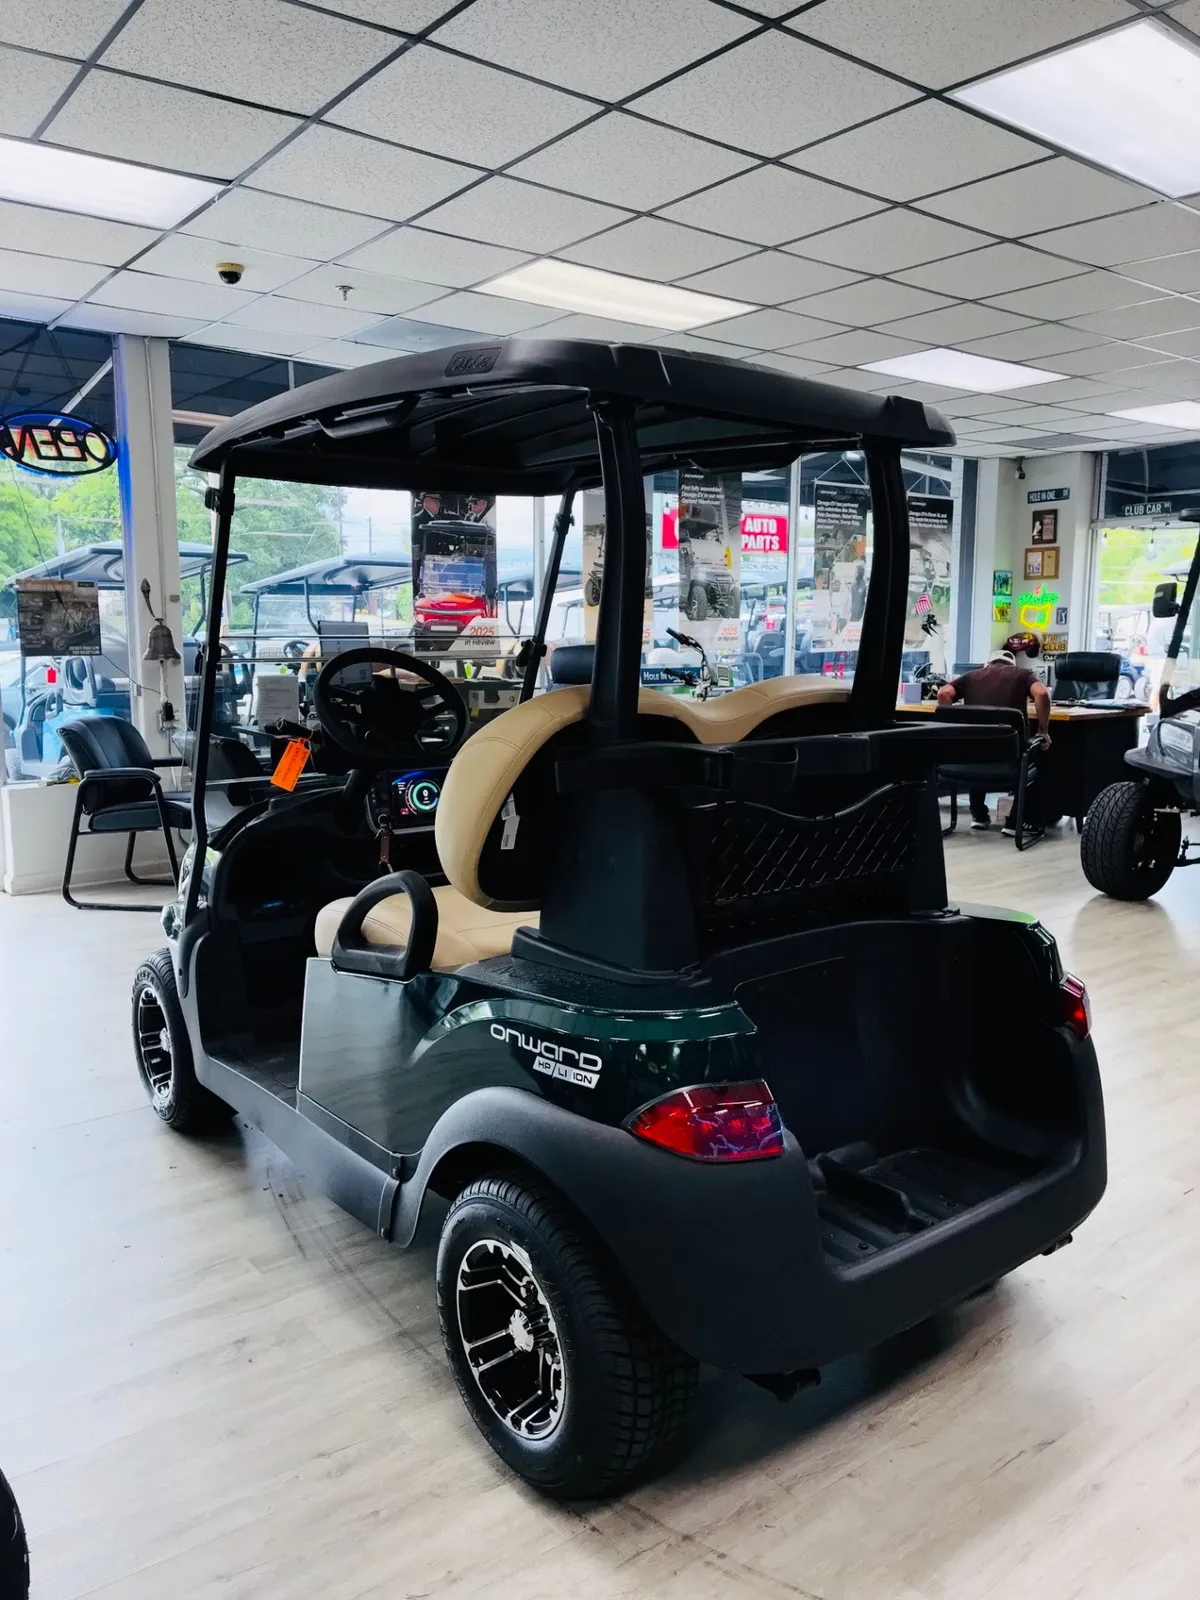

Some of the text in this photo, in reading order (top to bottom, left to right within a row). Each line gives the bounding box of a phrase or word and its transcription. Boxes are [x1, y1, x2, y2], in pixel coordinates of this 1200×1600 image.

[1124, 505, 1145, 516] CLUB
[1146, 503, 1162, 515] CAR
[744, 517, 778, 534] AUTO
[741, 534, 780, 550] PARTS
[470, 626, 495, 637] 2025
[538, 1061, 551, 1071] HP
[573, 1072, 593, 1085] ION
